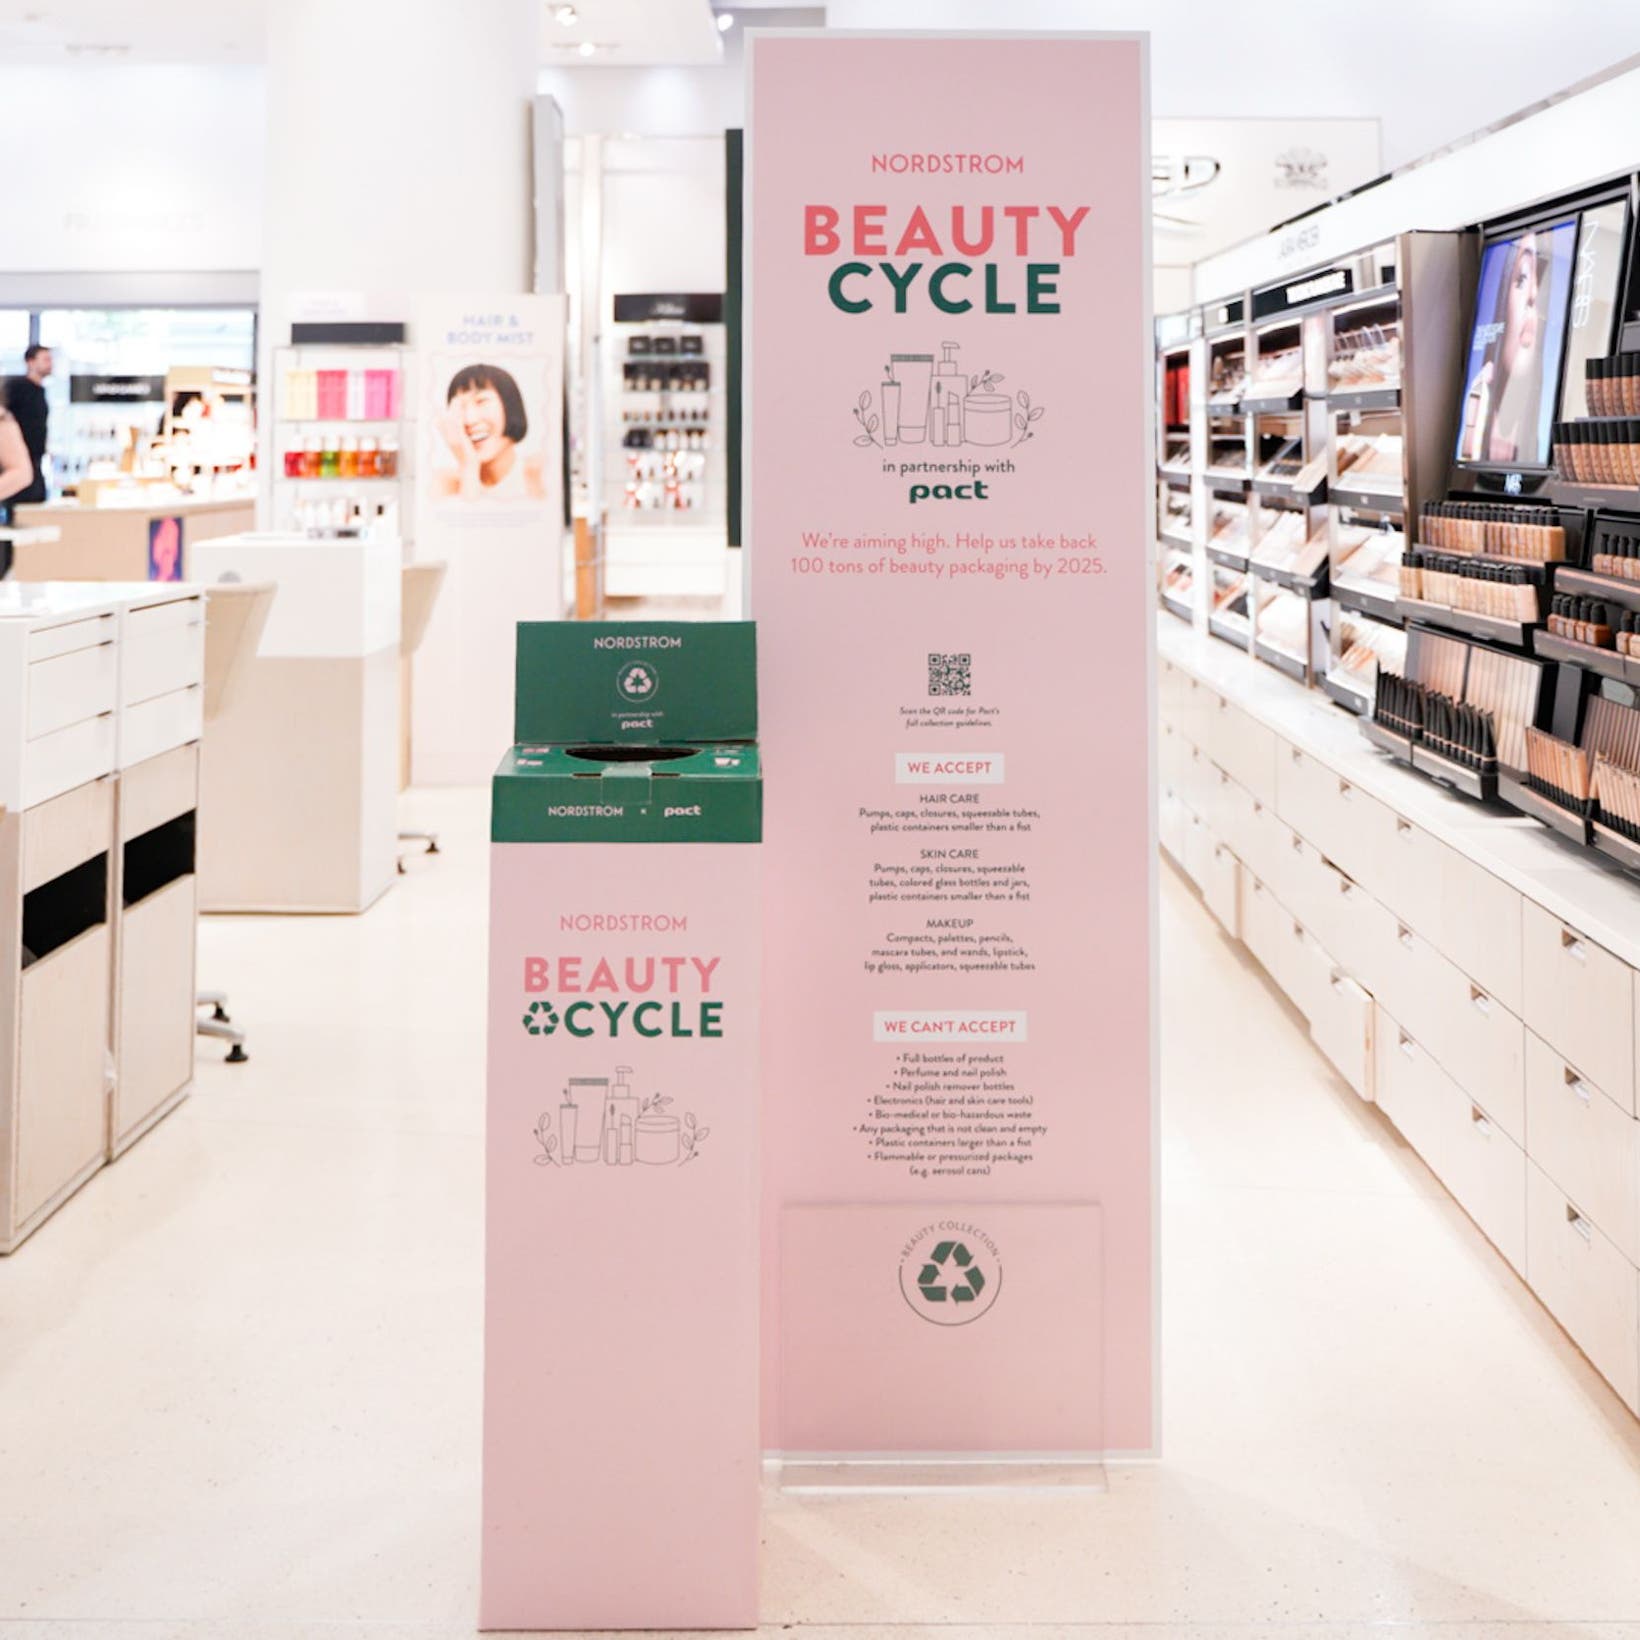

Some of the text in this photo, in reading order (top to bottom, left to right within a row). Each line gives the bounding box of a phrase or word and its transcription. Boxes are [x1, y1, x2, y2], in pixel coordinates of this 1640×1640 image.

[872, 153, 1024, 174] NORDSTROM
[804, 205, 1090, 257] BEAUTY
[828, 261, 1060, 315] CYCLE
[883, 459, 1015, 478] in partnership with
[909, 480, 988, 504] pact
[801, 532, 1097, 554] We're aiming high. Help us take back
[792, 554, 1107, 581] 100 tons of beauty packaging by 2025.
[594, 636, 681, 649] NORDSTROM
[900, 706, 1000, 717] Scan the QR code for Pact's
[621, 719, 653, 730] pact
[906, 719, 992, 729] full collection guidelines.
[908, 761, 991, 774] WE ACCEPT
[920, 793, 979, 804] HAIR CARE
[548, 805, 701, 817] NORDSTROM pact
[859, 807, 1040, 820] Pumps, caps, closures, squeezable tubes,
[871, 822, 898, 834] plastic
[902, 824, 949, 832] containers
[951, 822, 984, 831] smaller
[986, 822, 1006, 832] than
[1017, 821, 1031, 831] fist
[920, 849, 978, 859] SKIN CARE
[874, 863, 1025, 876] Pumps, caps, closures, squeezable
[869, 877, 1030, 890] tubes, colored glass bottles and jars,
[869, 891, 898, 903] plastic
[900, 893, 948, 901] containers
[950, 891, 982, 901] smaller
[985, 892, 1006, 901] than
[1016, 890, 1029, 901] fist
[560, 914, 687, 932] NORDSTROM
[926, 918, 973, 929] MAKEUP
[886, 932, 1013, 945] Compacts, palettes, pencils,
[910, 947, 938, 957] tubes,
[941, 947, 958, 957] and
[960, 947, 990, 957] wands,
[993, 947, 1028, 959] lipstick,
[864, 960, 1035, 974] lip gloss, applicators, squeezable tubes
[524, 956, 720, 994] BEAUTY
[564, 1001, 723, 1038] CYCLE
[884, 1020, 1016, 1033] WE CAN'T ACCEPT
[903, 1053, 1004, 1065] Full bottles of product
[901, 1066, 1006, 1080] Perfume and nail polish
[893, 1081, 912, 1091] Nail
[914, 1081, 940, 1094] polish
[983, 1082, 1014, 1091] bottles
[874, 1095, 923, 1105] Electronics
[925, 1095, 946, 1106] (hair
[948, 1095, 965, 1105] and
[967, 1096, 984, 1105] skin
[1008, 1095, 1033, 1105] tools)
[875, 1109, 929, 1119] Bio-medical
[942, 1109, 1004, 1119] bio-hazardous
[1007, 1111, 1032, 1119] waste
[859, 1123, 878, 1136] Any
[880, 1124, 925, 1137] packaging
[927, 1124, 945, 1133] that
[957, 1125, 972, 1133] not
[974, 1123, 997, 1133] clean
[1000, 1124, 1016, 1133] and
[1018, 1125, 1047, 1136] empty
[876, 1137, 905, 1147] Plastic
[958, 1138, 983, 1150] larger
[986, 1138, 1007, 1147] than
[1017, 1137, 1031, 1146] fist
[874, 1151, 925, 1161] Flammable
[939, 1151, 990, 1164] pressurized
[992, 1152, 1033, 1164] packages
[910, 1165, 990, 1178] (e.g. aerosol cans)
[900, 1219, 999, 1258] BEAUTY COLLECTION
